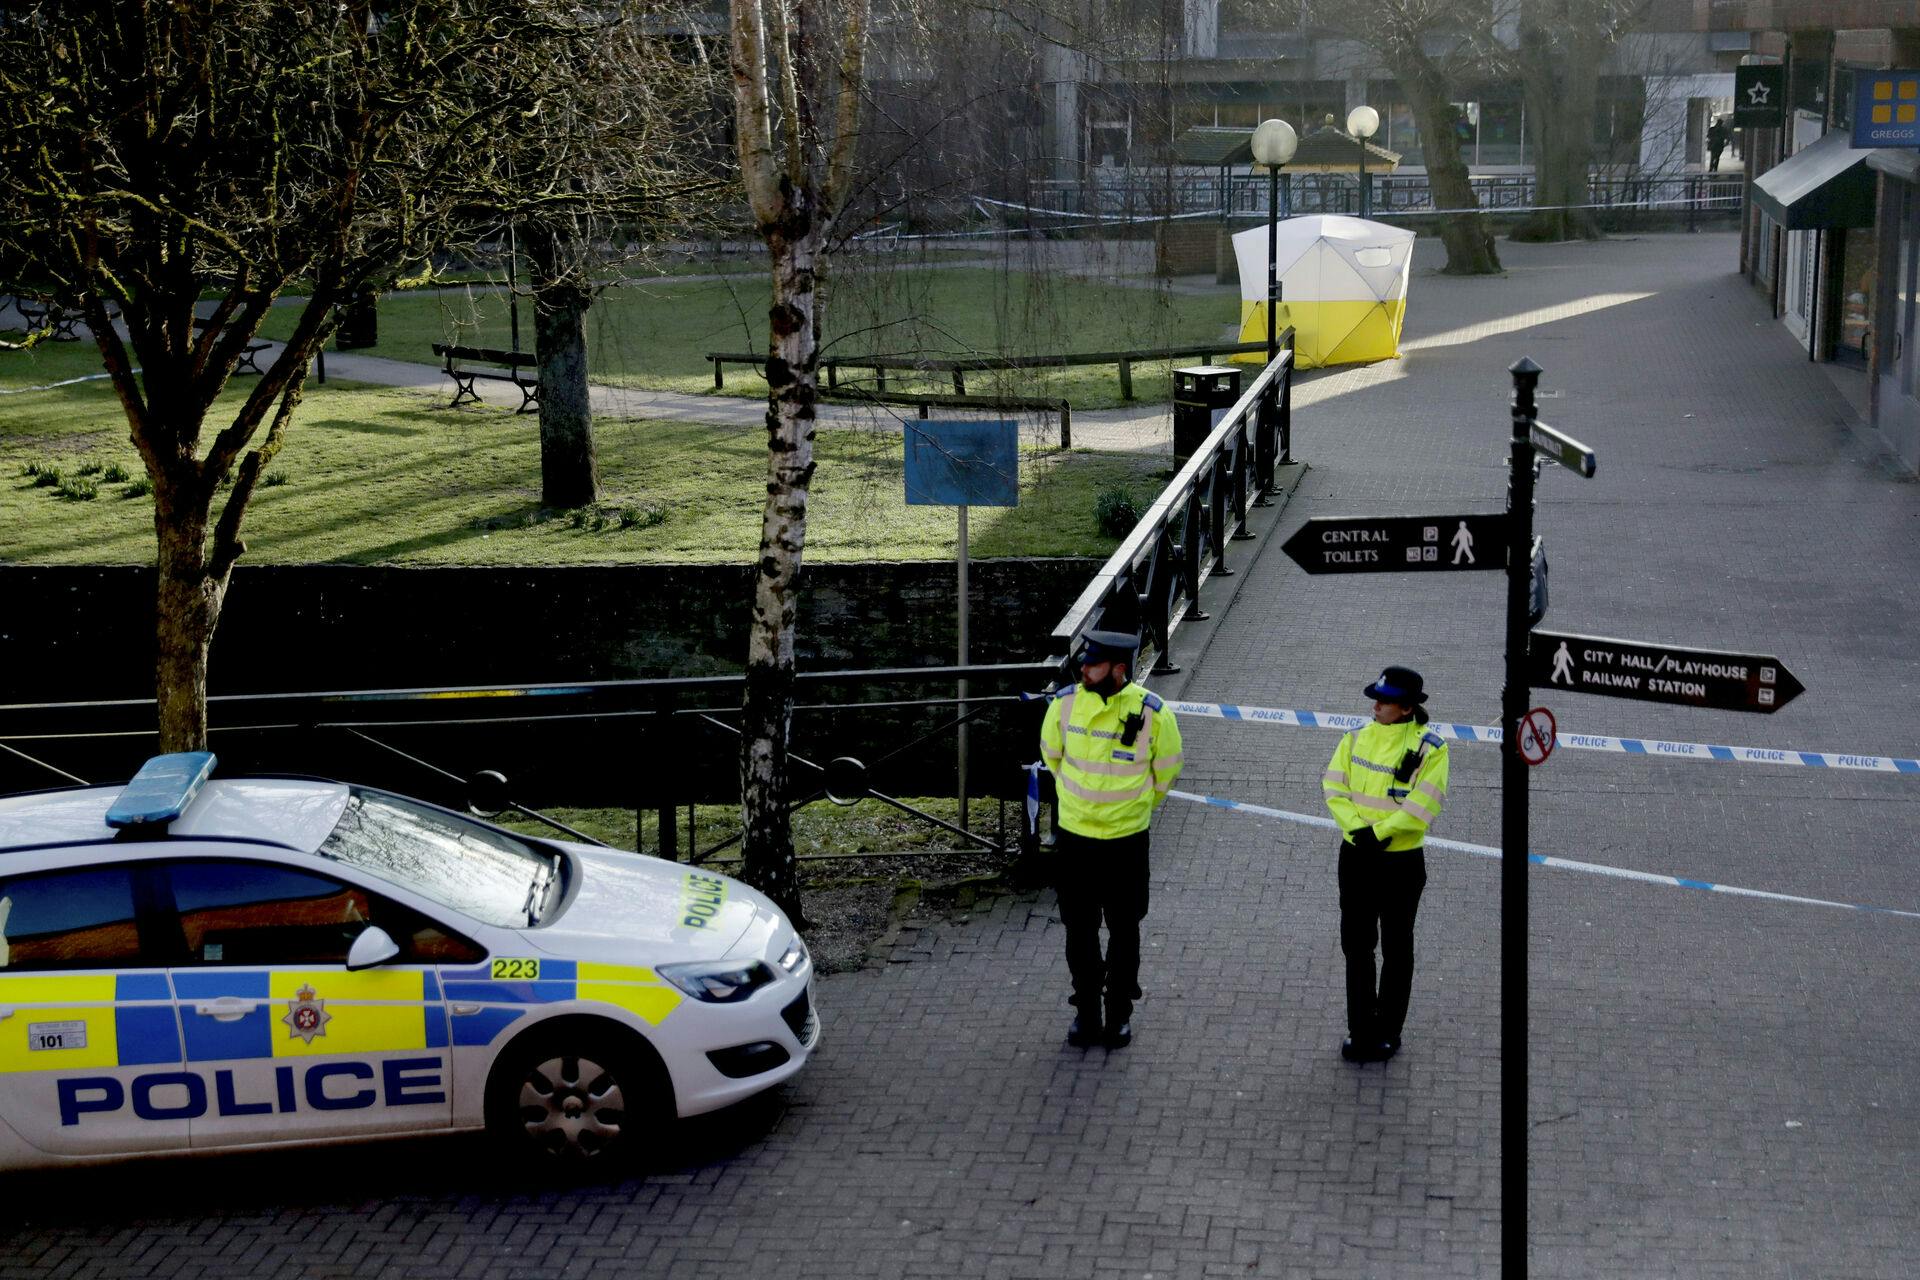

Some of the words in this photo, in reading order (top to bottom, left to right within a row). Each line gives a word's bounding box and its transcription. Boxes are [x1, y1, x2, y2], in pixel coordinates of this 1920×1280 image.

[1870, 129, 1915, 139] GREGGS
[1322, 530, 1389, 544] CENTRAL
[1323, 550, 1379, 563] TOILETS
[1584, 650, 1614, 664] CITY
[1621, 654, 1748, 680] HALL/PLAYHOUSE
[1582, 671, 1641, 689] RAILWAY
[1648, 678, 1706, 697] STATION
[1251, 710, 1286, 720] POLICE
[1327, 715, 1362, 727] POLICE
[1570, 735, 1608, 748] POLICE
[1656, 742, 1696, 754] POLICE
[1745, 748, 1785, 761] POLICE
[1838, 755, 1880, 768] POLICE
[684, 874, 722, 931] POLICE
[493, 959, 538, 979] 223
[40, 1035, 62, 1048] 101
[57, 1056, 446, 1126] POLICE
